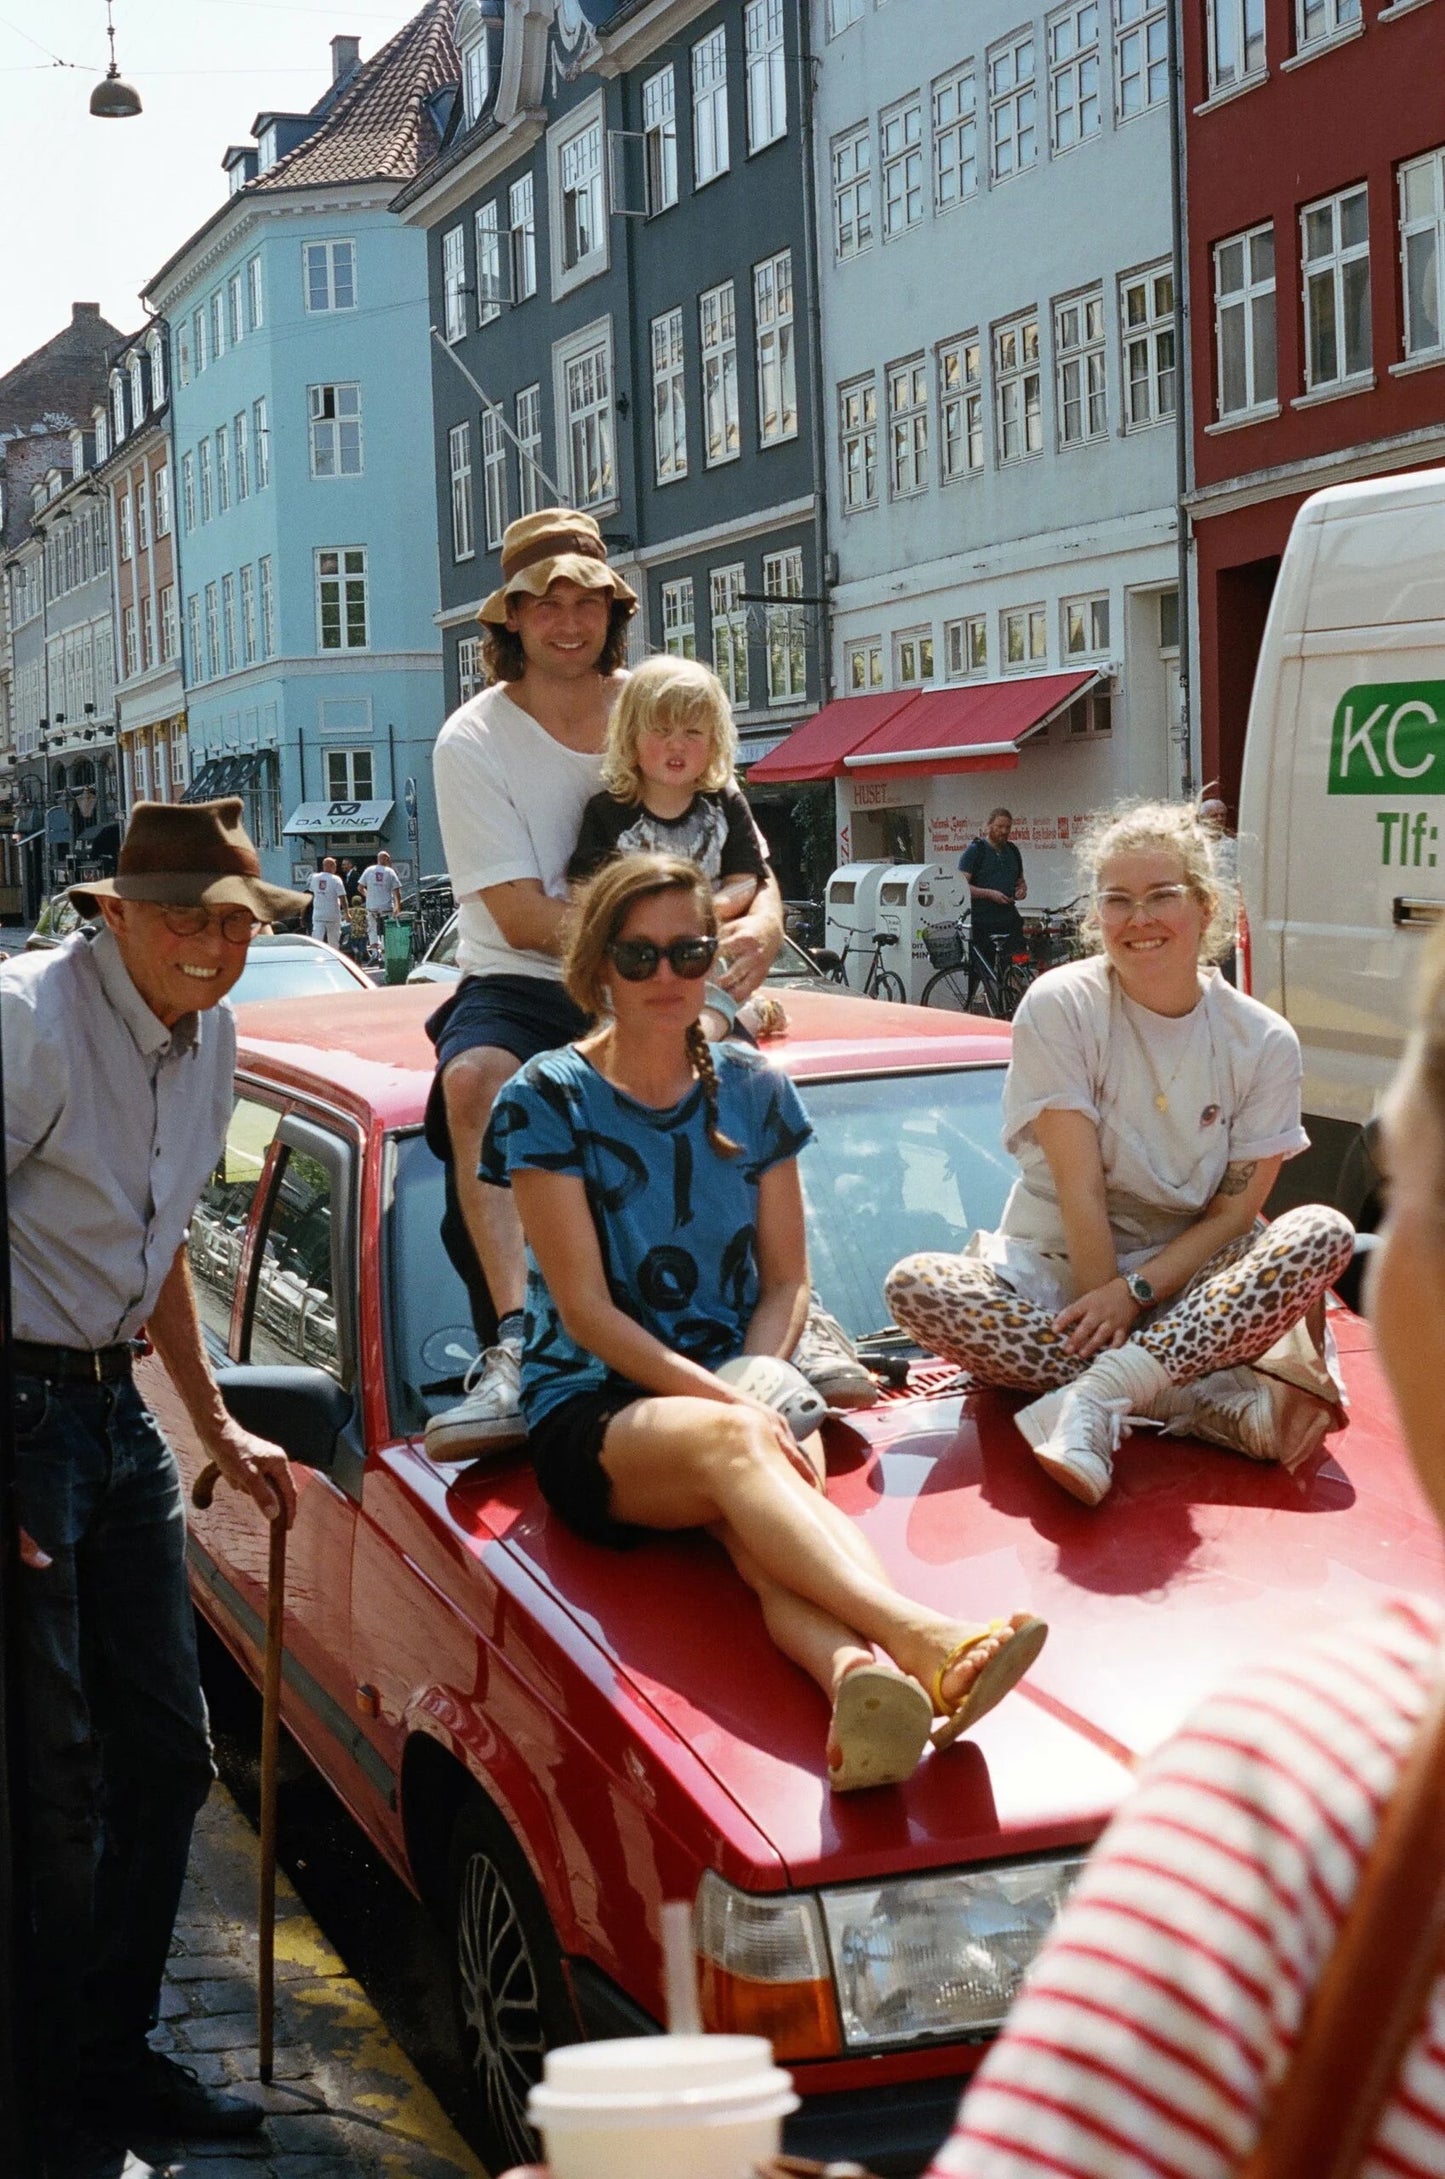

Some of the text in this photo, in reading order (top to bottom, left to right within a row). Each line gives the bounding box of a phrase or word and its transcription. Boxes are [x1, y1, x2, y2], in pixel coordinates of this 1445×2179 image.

[1339, 699, 1439, 779] KC
[853, 783, 887, 805] HUSET
[329, 817, 380, 826] VINCI
[1376, 811, 1438, 867] Tlf:
